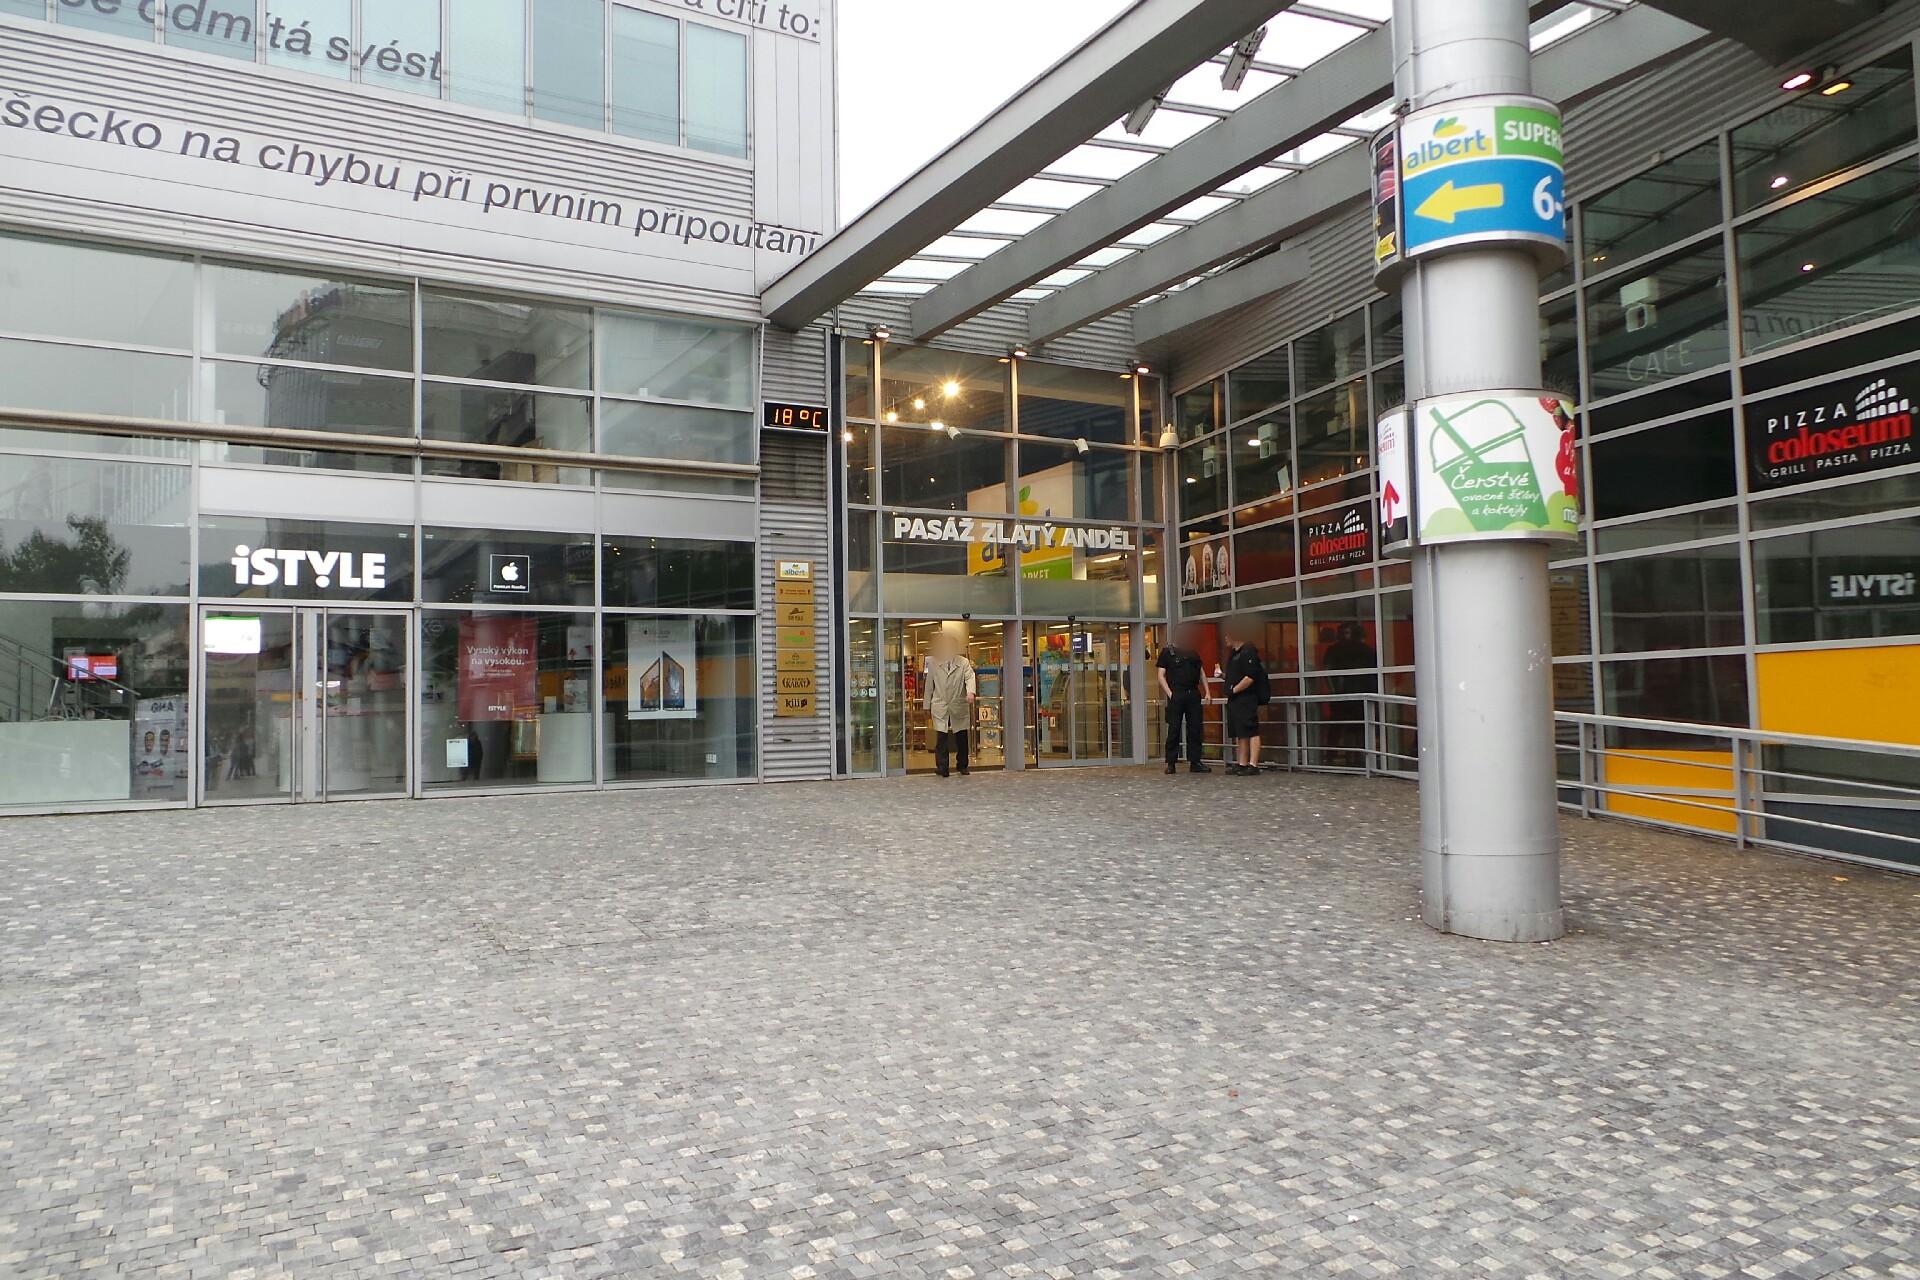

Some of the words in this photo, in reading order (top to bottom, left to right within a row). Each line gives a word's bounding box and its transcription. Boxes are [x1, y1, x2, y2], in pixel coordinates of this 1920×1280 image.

[779, 4, 820, 38] to:
[0, 92, 162, 149] šecko
[180, 130, 240, 164] na
[258, 143, 400, 190] chybu
[413, 169, 472, 202] při
[483, 181, 622, 226] prvním
[1407, 129, 1488, 169] albert
[775, 408, 793, 425] 18
[800, 409, 822, 428] °C
[1767, 402, 1848, 434] PIZZA
[1768, 413, 1912, 464] coloseum
[1769, 463, 1806, 478] GRILL
[1816, 453, 1858, 469] PASTA
[1870, 442, 1912, 459] PIZZA
[1451, 465, 1529, 490] Čerstvé
[1462, 491, 1504, 502] ovocné
[1483, 504, 1528, 518] koktejly
[894, 516, 975, 542] PASÁŽ
[982, 522, 1057, 546] ZLATÝ
[1061, 527, 1136, 551] ANDĚL
[1309, 522, 1341, 538] PIZZA
[1310, 533, 1366, 557] coloseum
[1329, 554, 1345, 563] PASTA
[1349, 550, 1366, 559] PIZZA
[231, 544, 386, 589] iSTYLE
[466, 646, 499, 656] Vysoký
[501, 646, 529, 656] výkon
